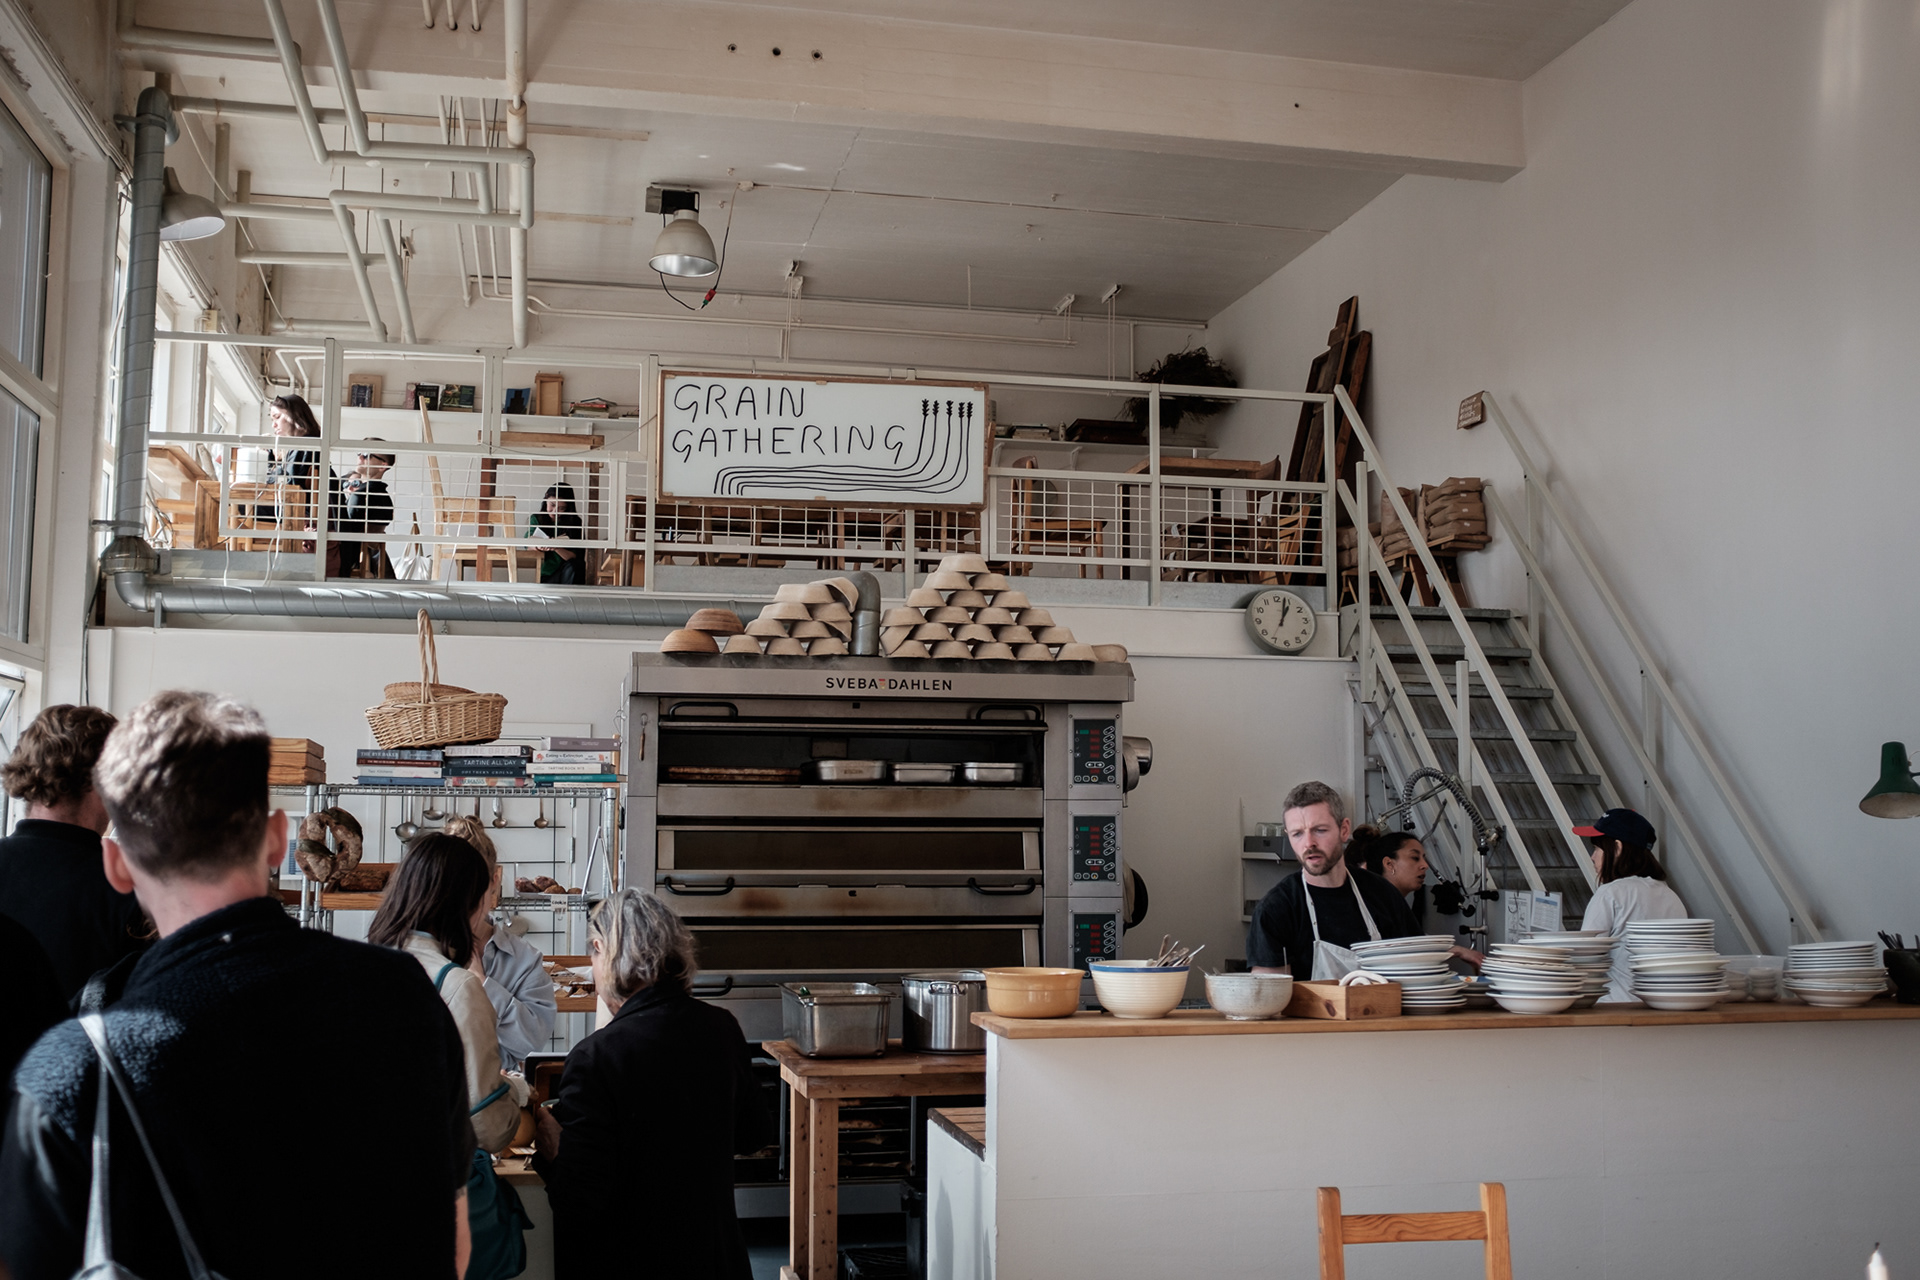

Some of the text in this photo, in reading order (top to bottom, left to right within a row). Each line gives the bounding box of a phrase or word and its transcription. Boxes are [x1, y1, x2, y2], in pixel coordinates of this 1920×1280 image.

[674, 384, 804, 423] GRAIN
[672, 425, 905, 464] GATHERING
[1273, 595, 1281, 603] 12
[825, 677, 952, 691] SVEBA DAHLEN
[446, 747, 520, 755] TARTINE BREAD
